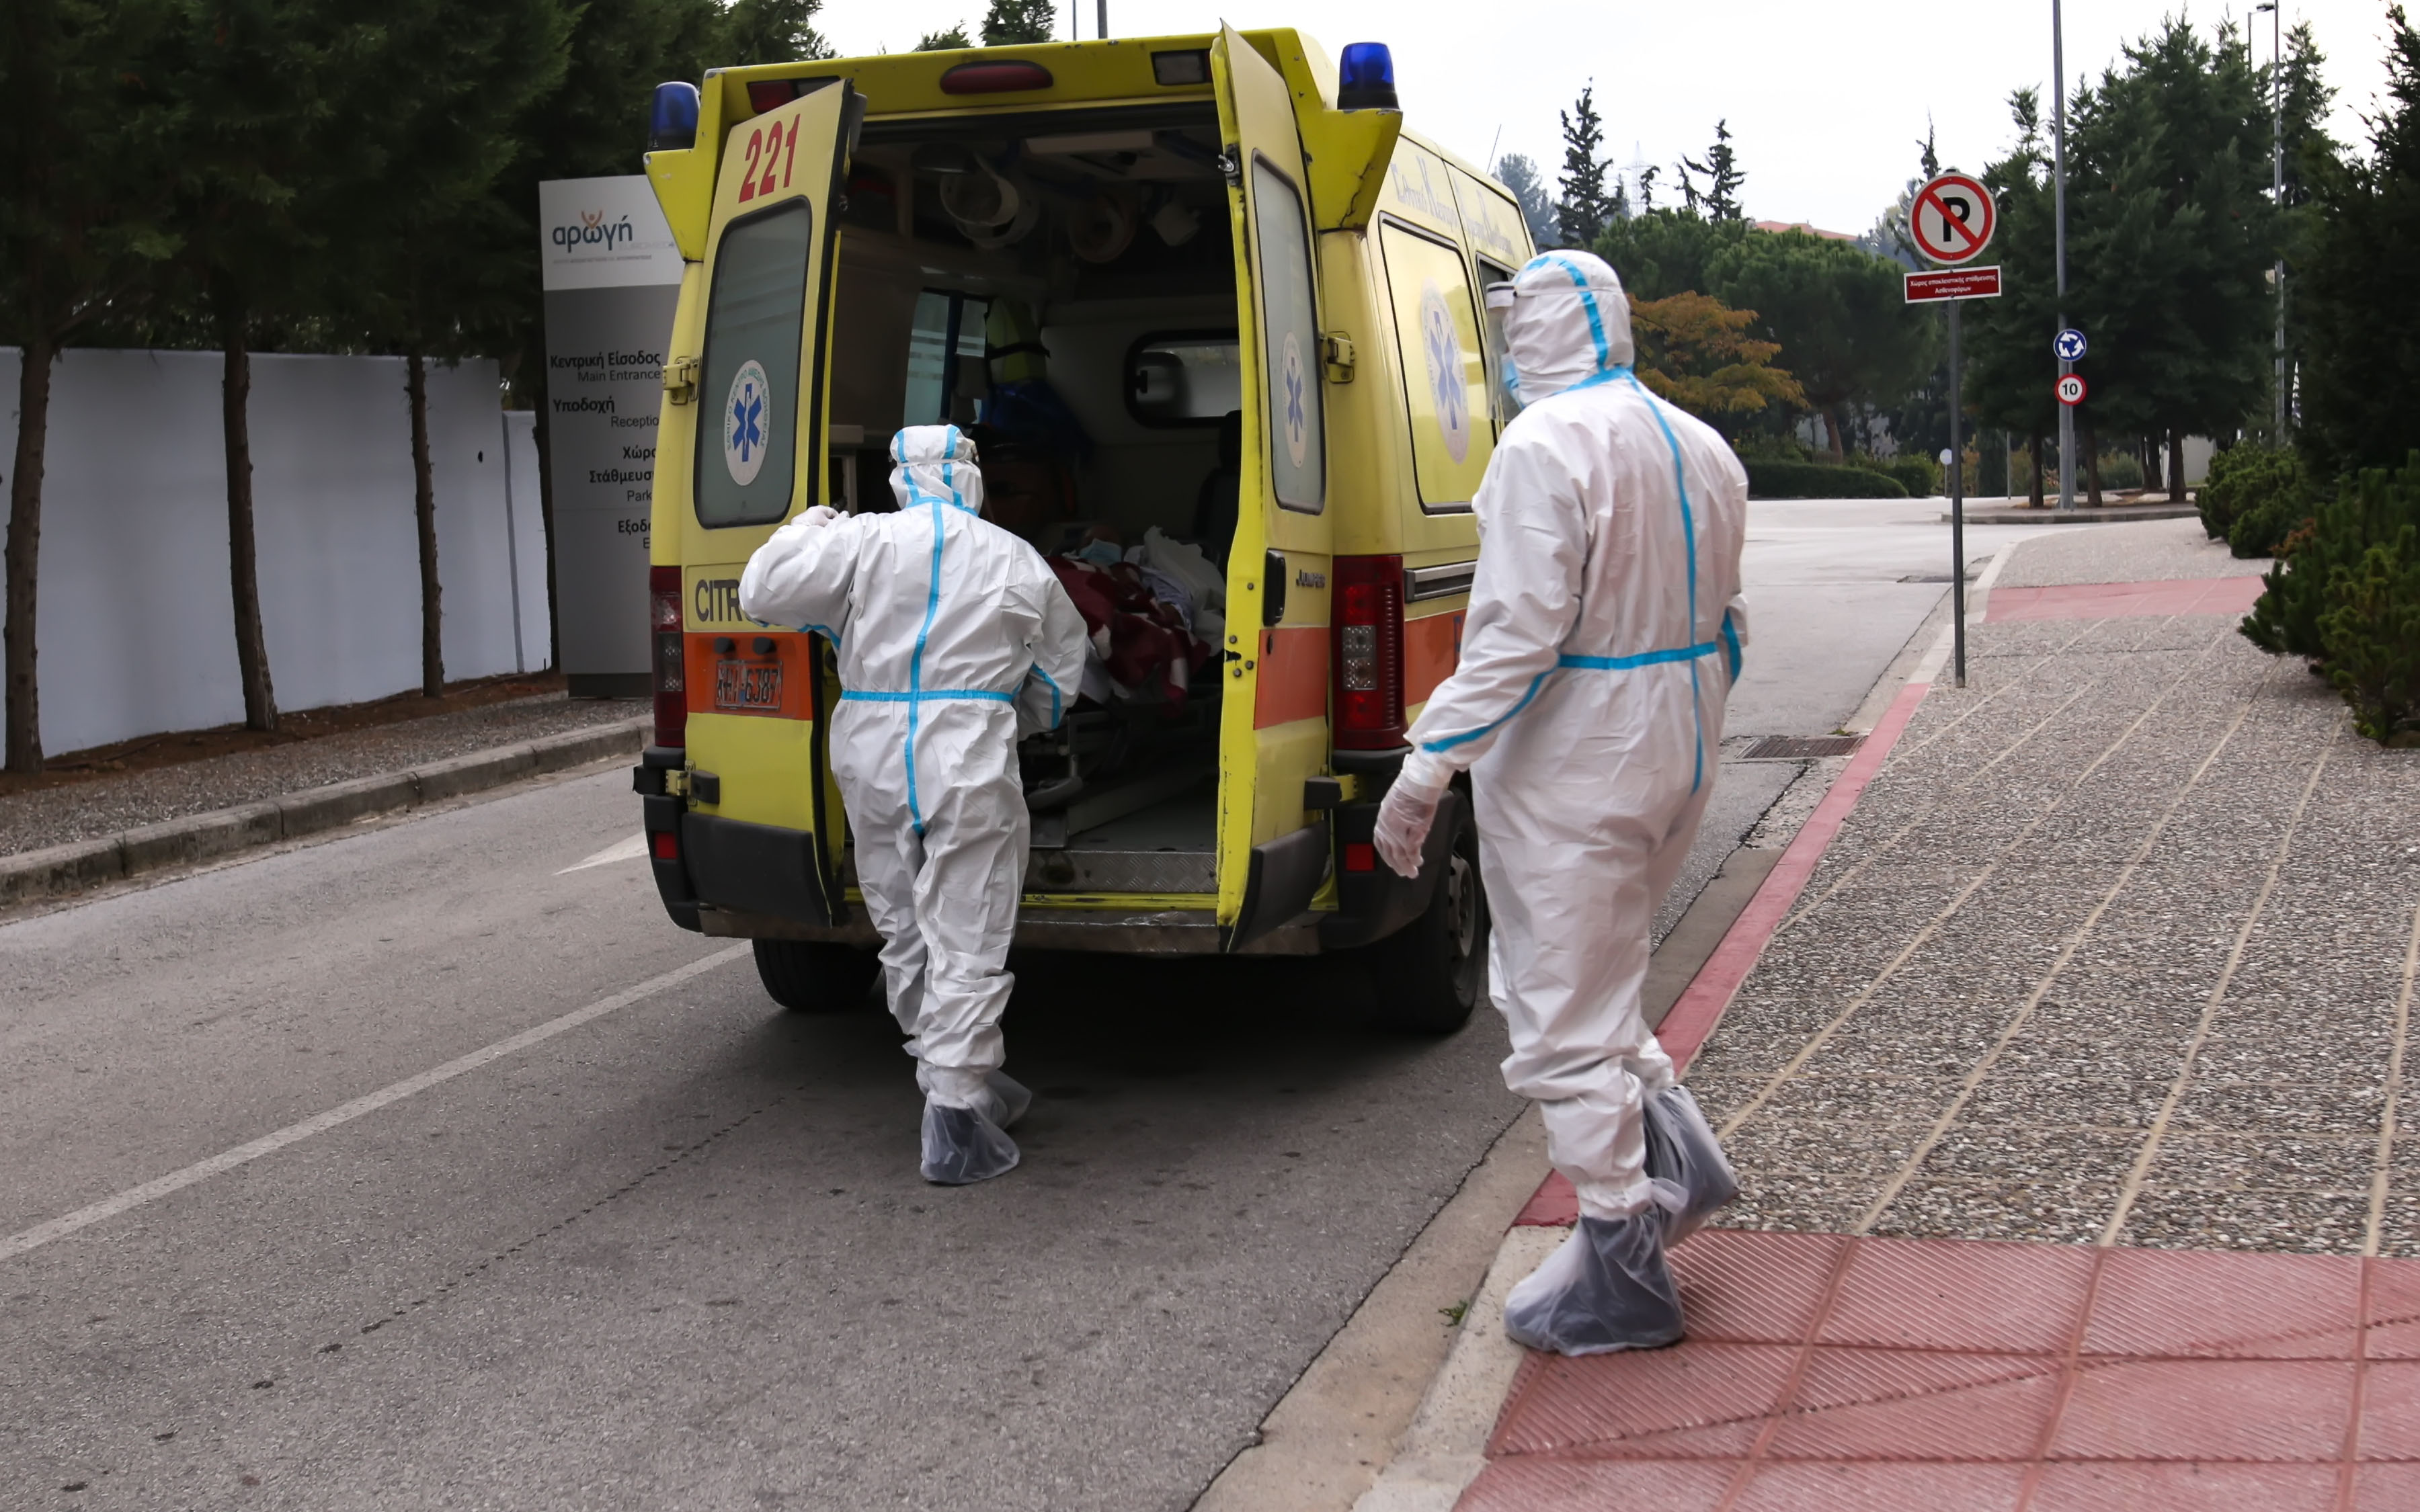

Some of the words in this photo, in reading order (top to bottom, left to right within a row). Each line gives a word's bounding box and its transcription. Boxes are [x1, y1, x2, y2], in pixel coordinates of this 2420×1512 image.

[738, 113, 801, 204] 221
[1942, 196, 1970, 242] P
[552, 214, 633, 254] αρωγή
[550, 351, 604, 369] Κεντρική
[608, 350, 661, 367] Είσοδος
[578, 371, 606, 382] Main
[609, 370, 661, 382] Entrance
[2062, 383, 2079, 396] 10
[553, 395, 614, 413] Υποδοχή
[610, 415, 659, 429] Receptio
[589, 468, 655, 485] Στάθμευσ
[627, 489, 653, 502] Park
[695, 579, 743, 622] CITR
